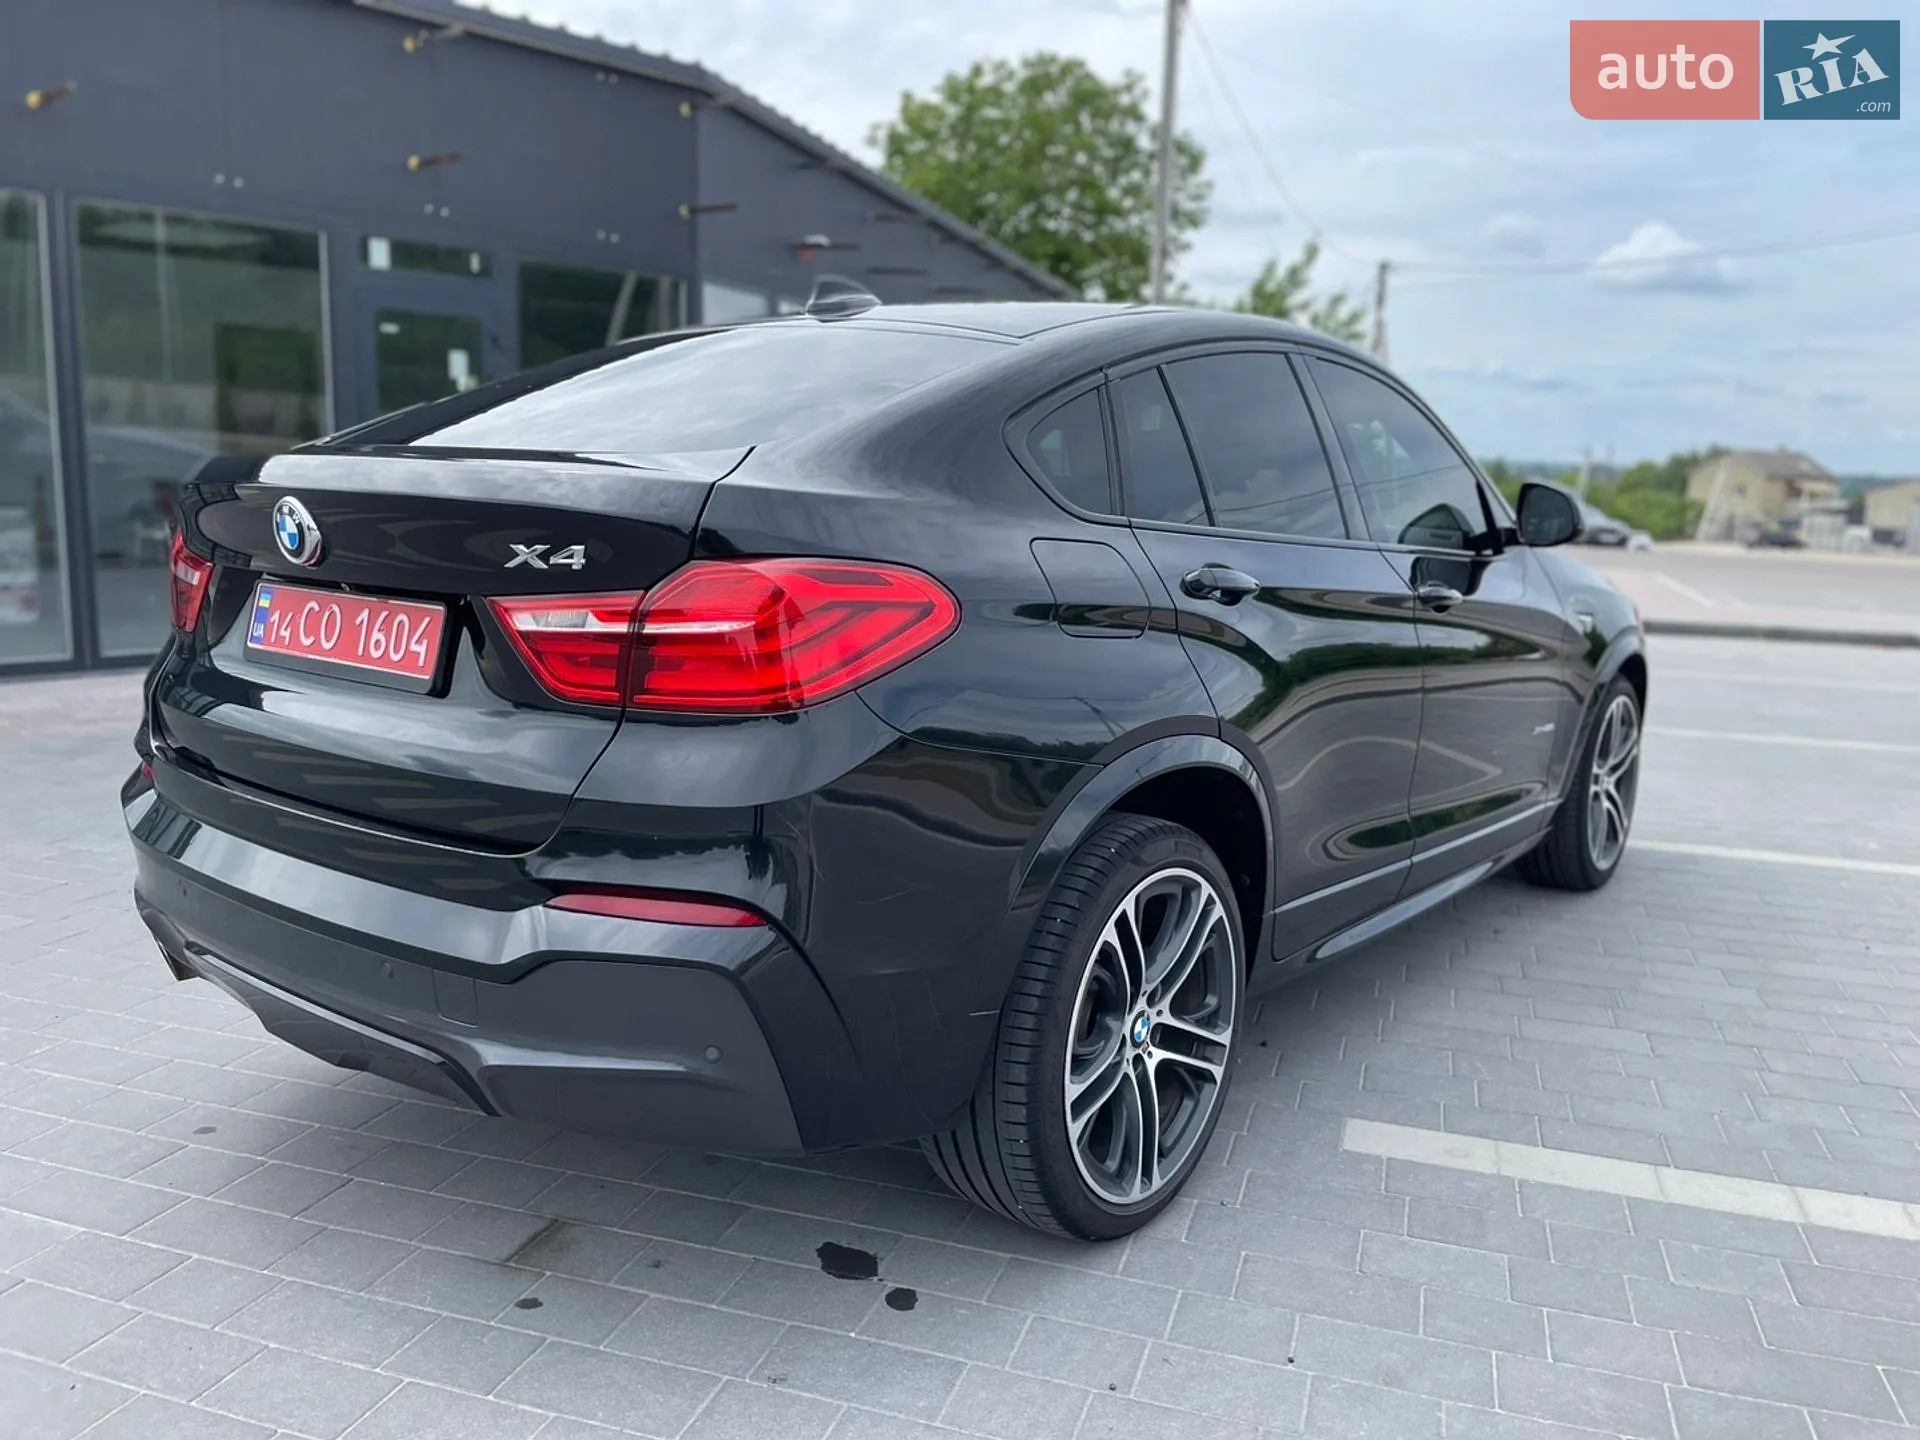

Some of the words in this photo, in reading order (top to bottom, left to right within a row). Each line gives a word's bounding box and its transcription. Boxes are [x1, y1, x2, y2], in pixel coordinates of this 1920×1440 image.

[504, 544, 586, 570] X4
[253, 622, 265, 638] UA
[355, 607, 432, 667] 1604
